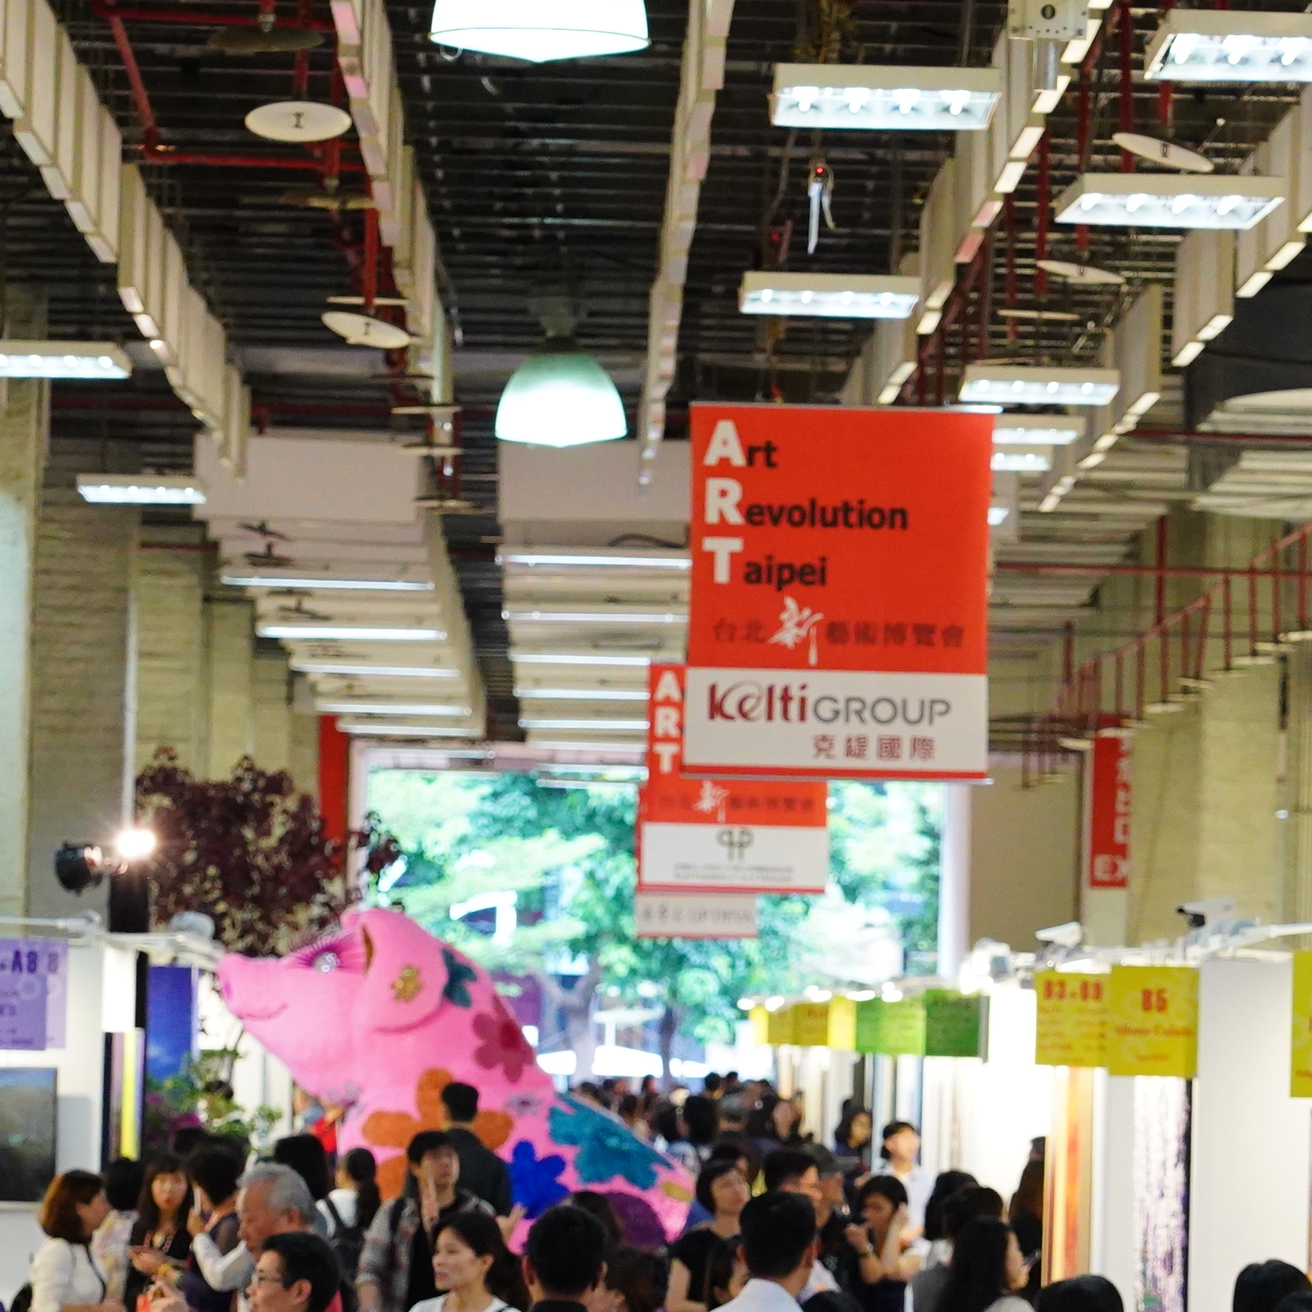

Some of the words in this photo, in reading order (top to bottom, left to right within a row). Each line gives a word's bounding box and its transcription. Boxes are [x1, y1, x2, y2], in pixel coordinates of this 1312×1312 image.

[703, 419, 778, 468] Art
[703, 477, 908, 531] Revolution
[702, 537, 828, 591] Taipei
